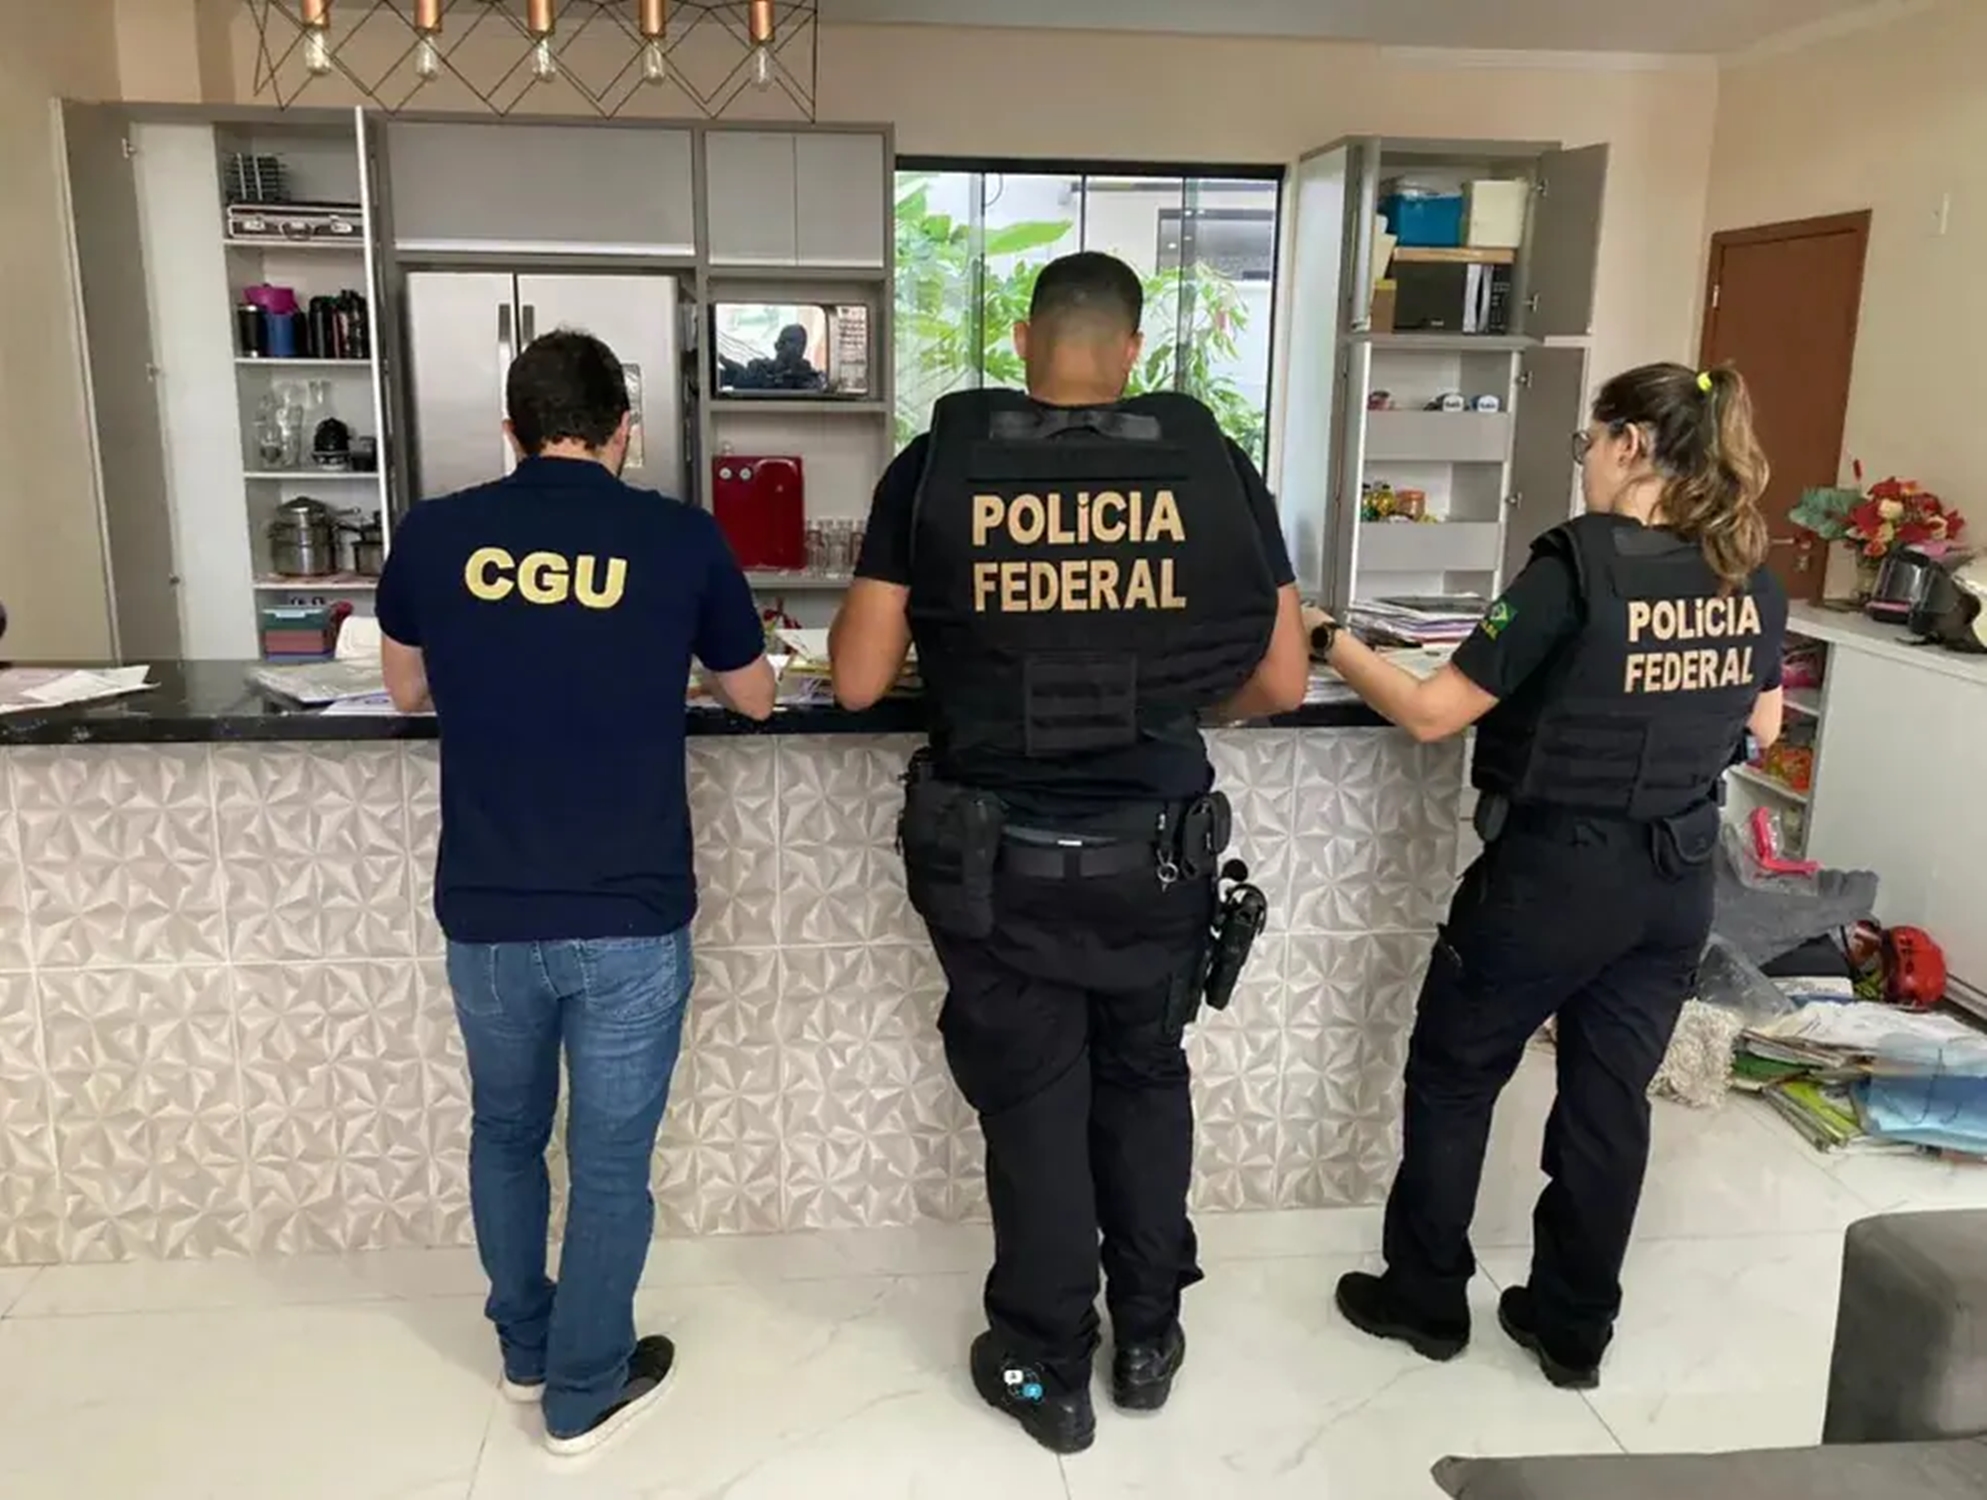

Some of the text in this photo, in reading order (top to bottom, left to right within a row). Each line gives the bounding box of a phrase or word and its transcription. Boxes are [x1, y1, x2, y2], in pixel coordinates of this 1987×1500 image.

[465, 547, 628, 609] CGU
[973, 558, 1187, 612] FEDERAL
[1624, 646, 1754, 693] FEDERAL
